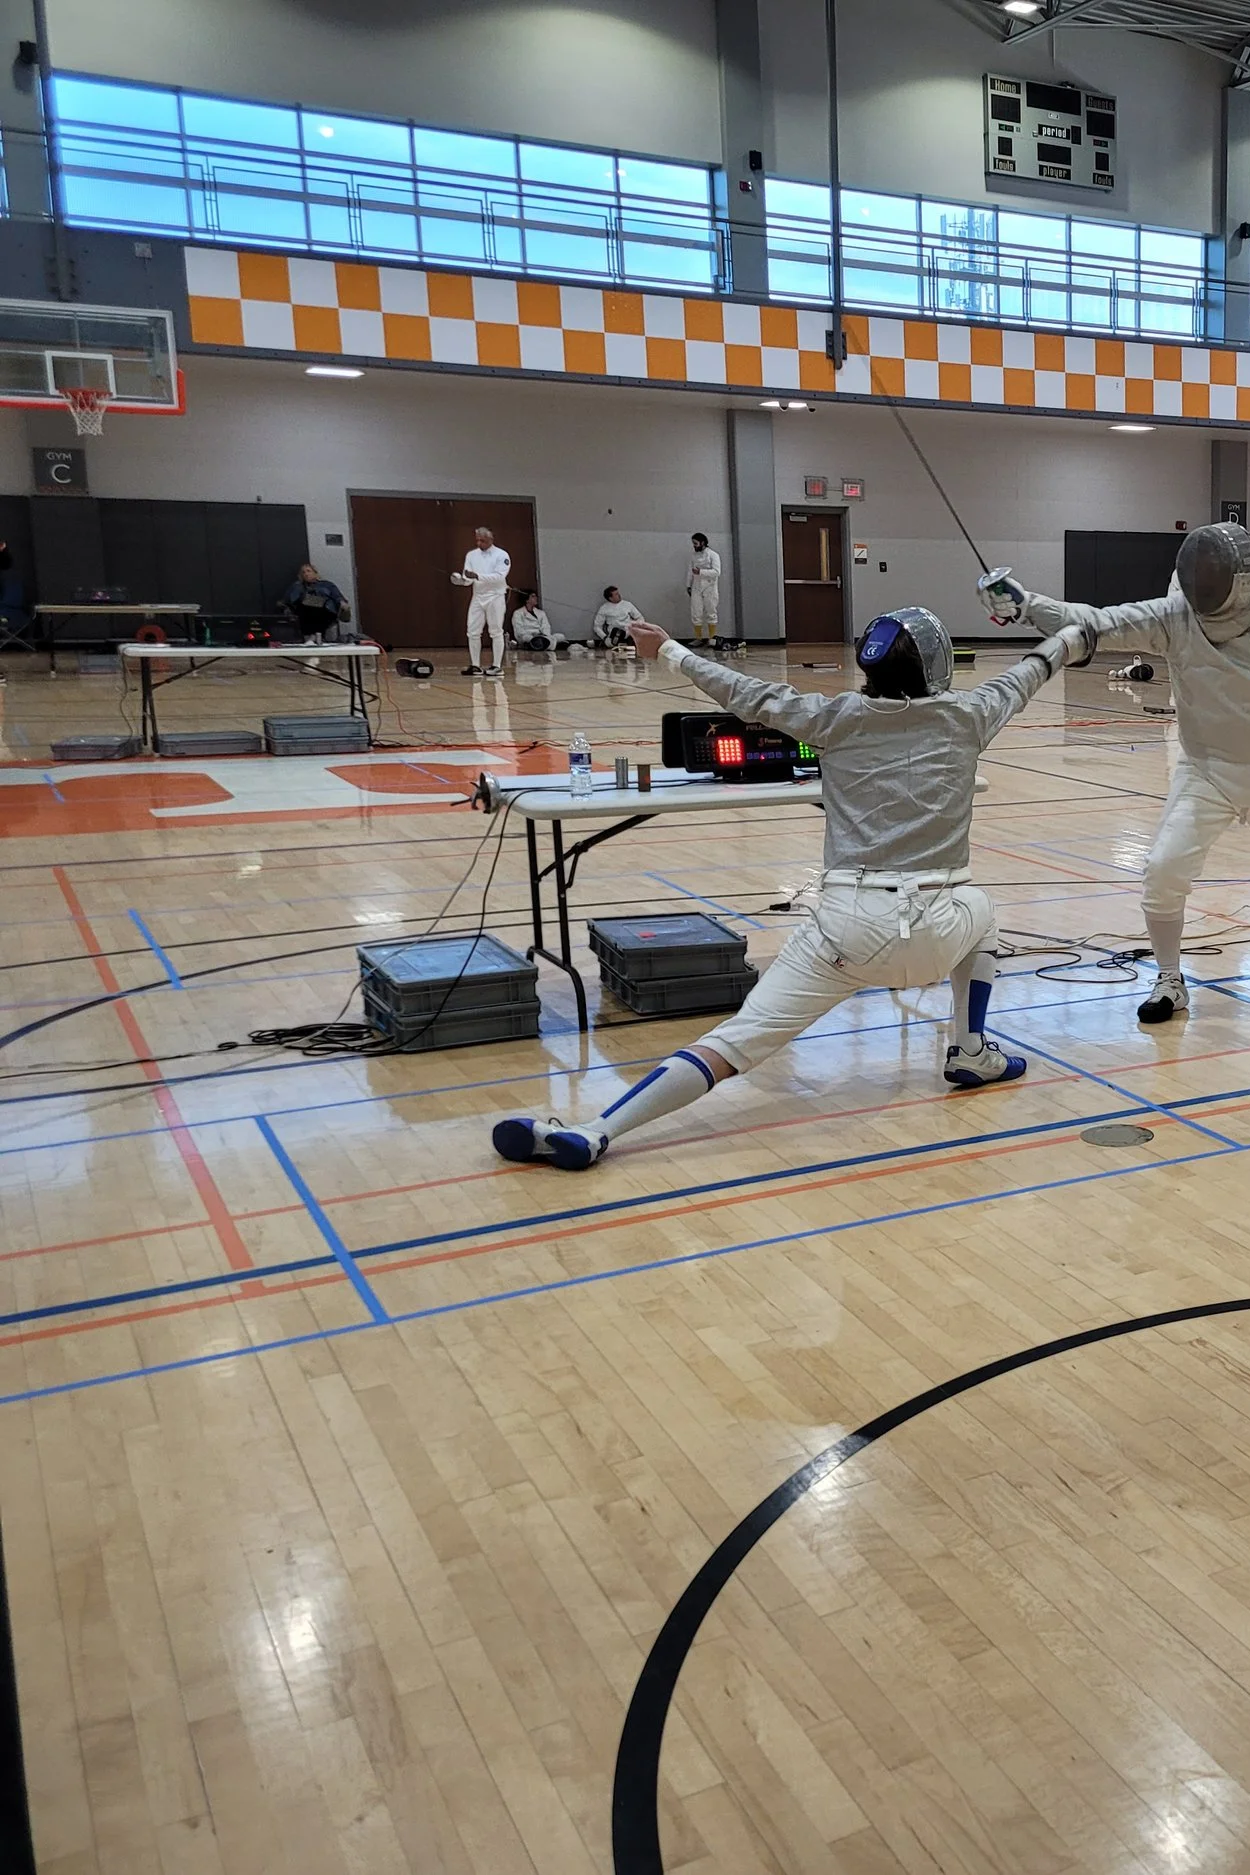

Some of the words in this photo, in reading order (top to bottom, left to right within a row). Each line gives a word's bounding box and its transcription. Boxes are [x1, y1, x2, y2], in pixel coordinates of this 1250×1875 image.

[995, 79, 1017, 93] Home
[1042, 126, 1067, 139] period
[996, 158, 1014, 172] fouls
[1042, 166, 1068, 180] player
[46, 451, 72, 461] GYM
[51, 463, 72, 484] C
[1227, 503, 1241, 511] GYM
